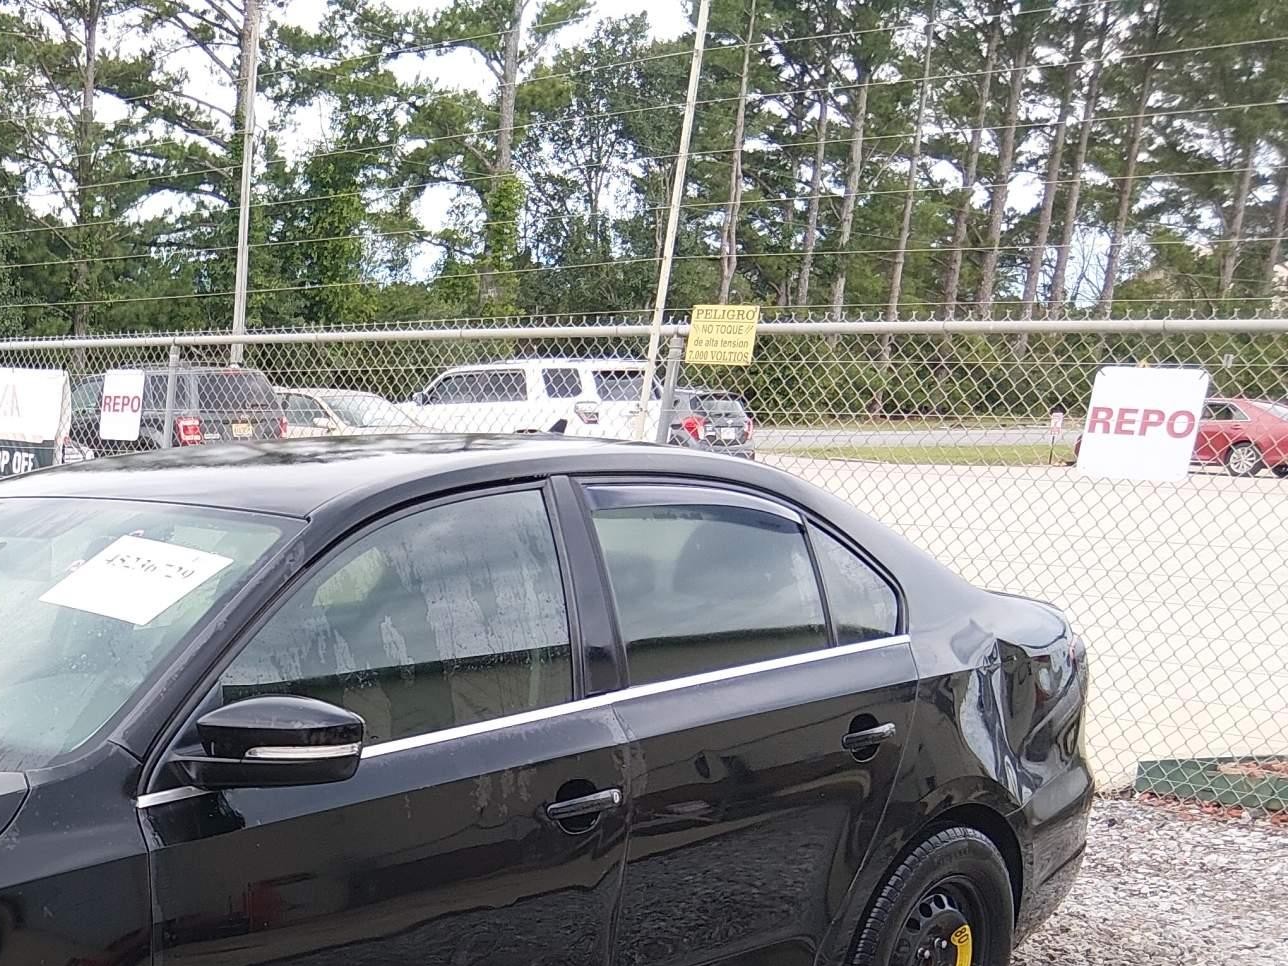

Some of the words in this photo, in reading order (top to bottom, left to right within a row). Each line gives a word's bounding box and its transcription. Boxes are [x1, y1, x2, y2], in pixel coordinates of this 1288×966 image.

[695, 308, 755, 321] PELIGRO
[702, 325, 713, 335] NO
[716, 325, 743, 335] TOQUE
[694, 337, 703, 346] de
[705, 338, 718, 347] alta
[721, 339, 748, 348] tension
[689, 351, 708, 361] 7.000
[710, 351, 749, 362] VOLTIOS
[103, 395, 141, 413] REPO
[1087, 406, 1196, 439] REPO
[12, 451, 35, 474] OFF
[954, 927, 969, 945] 80
